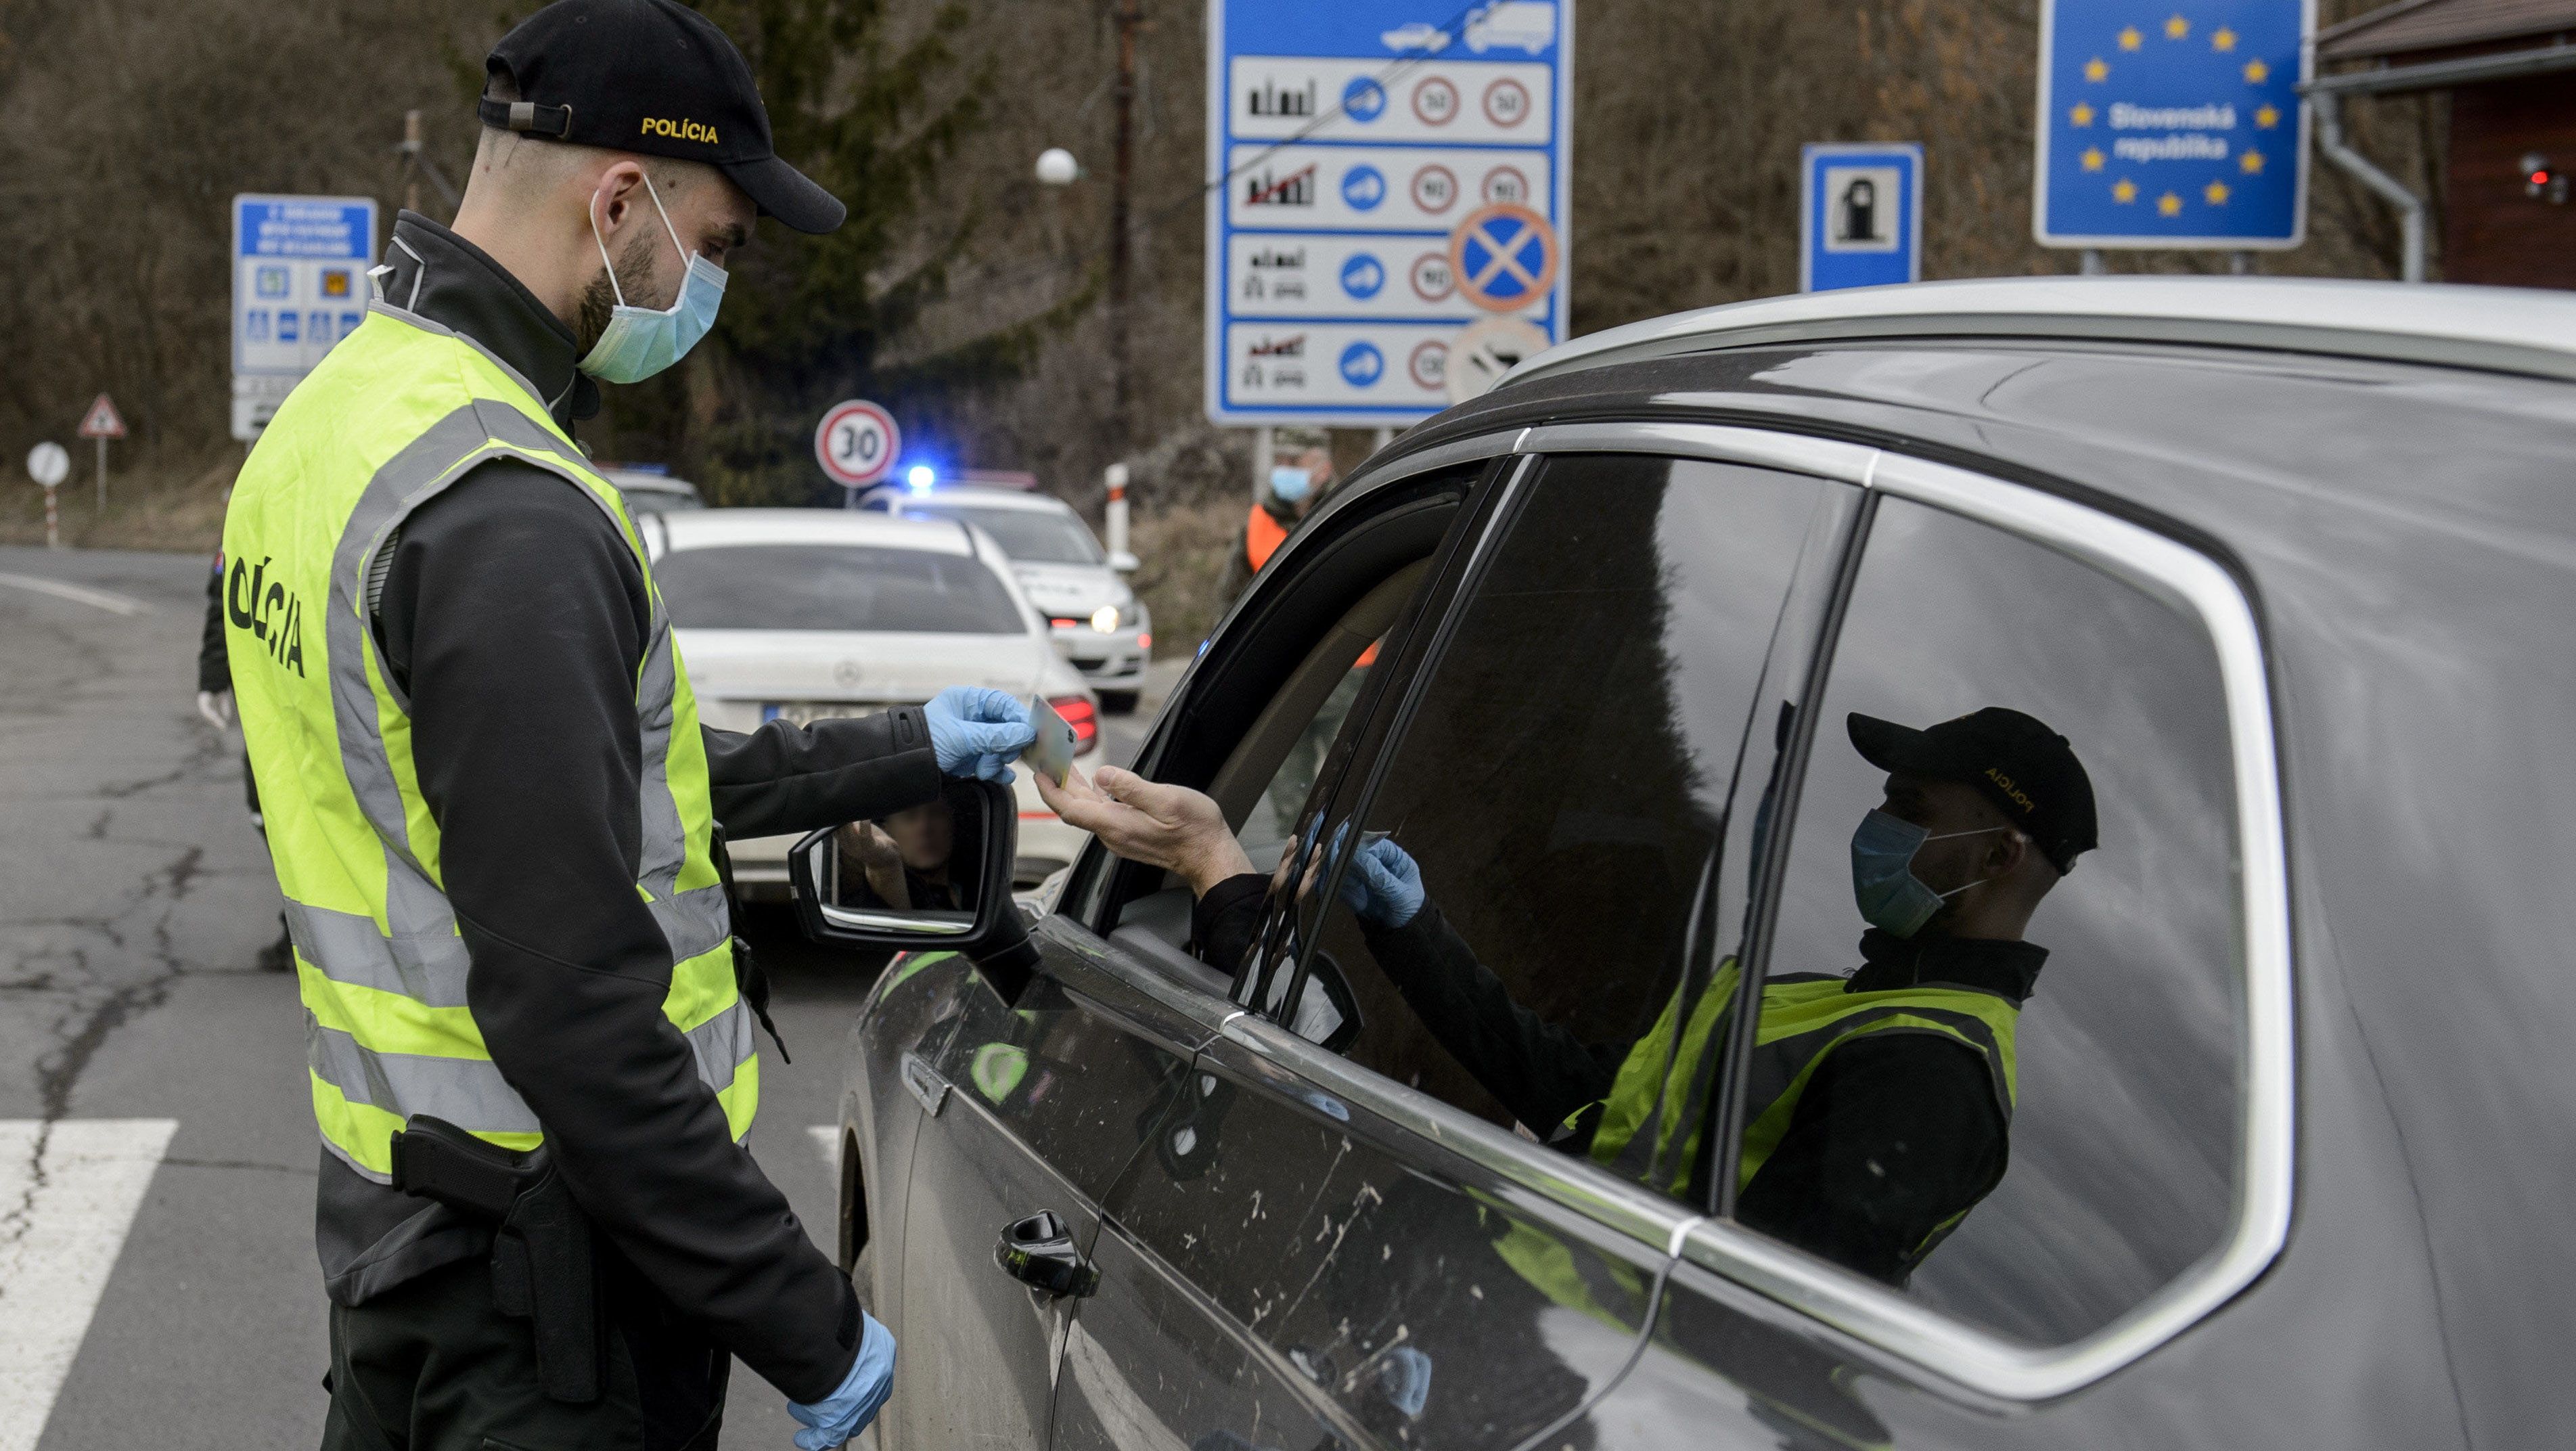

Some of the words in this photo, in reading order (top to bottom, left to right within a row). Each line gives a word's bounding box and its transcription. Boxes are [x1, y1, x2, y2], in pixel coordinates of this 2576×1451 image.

[641, 118, 719, 144] POLÍCIA
[2114, 134, 2228, 163] republika
[840, 425, 879, 461] 30
